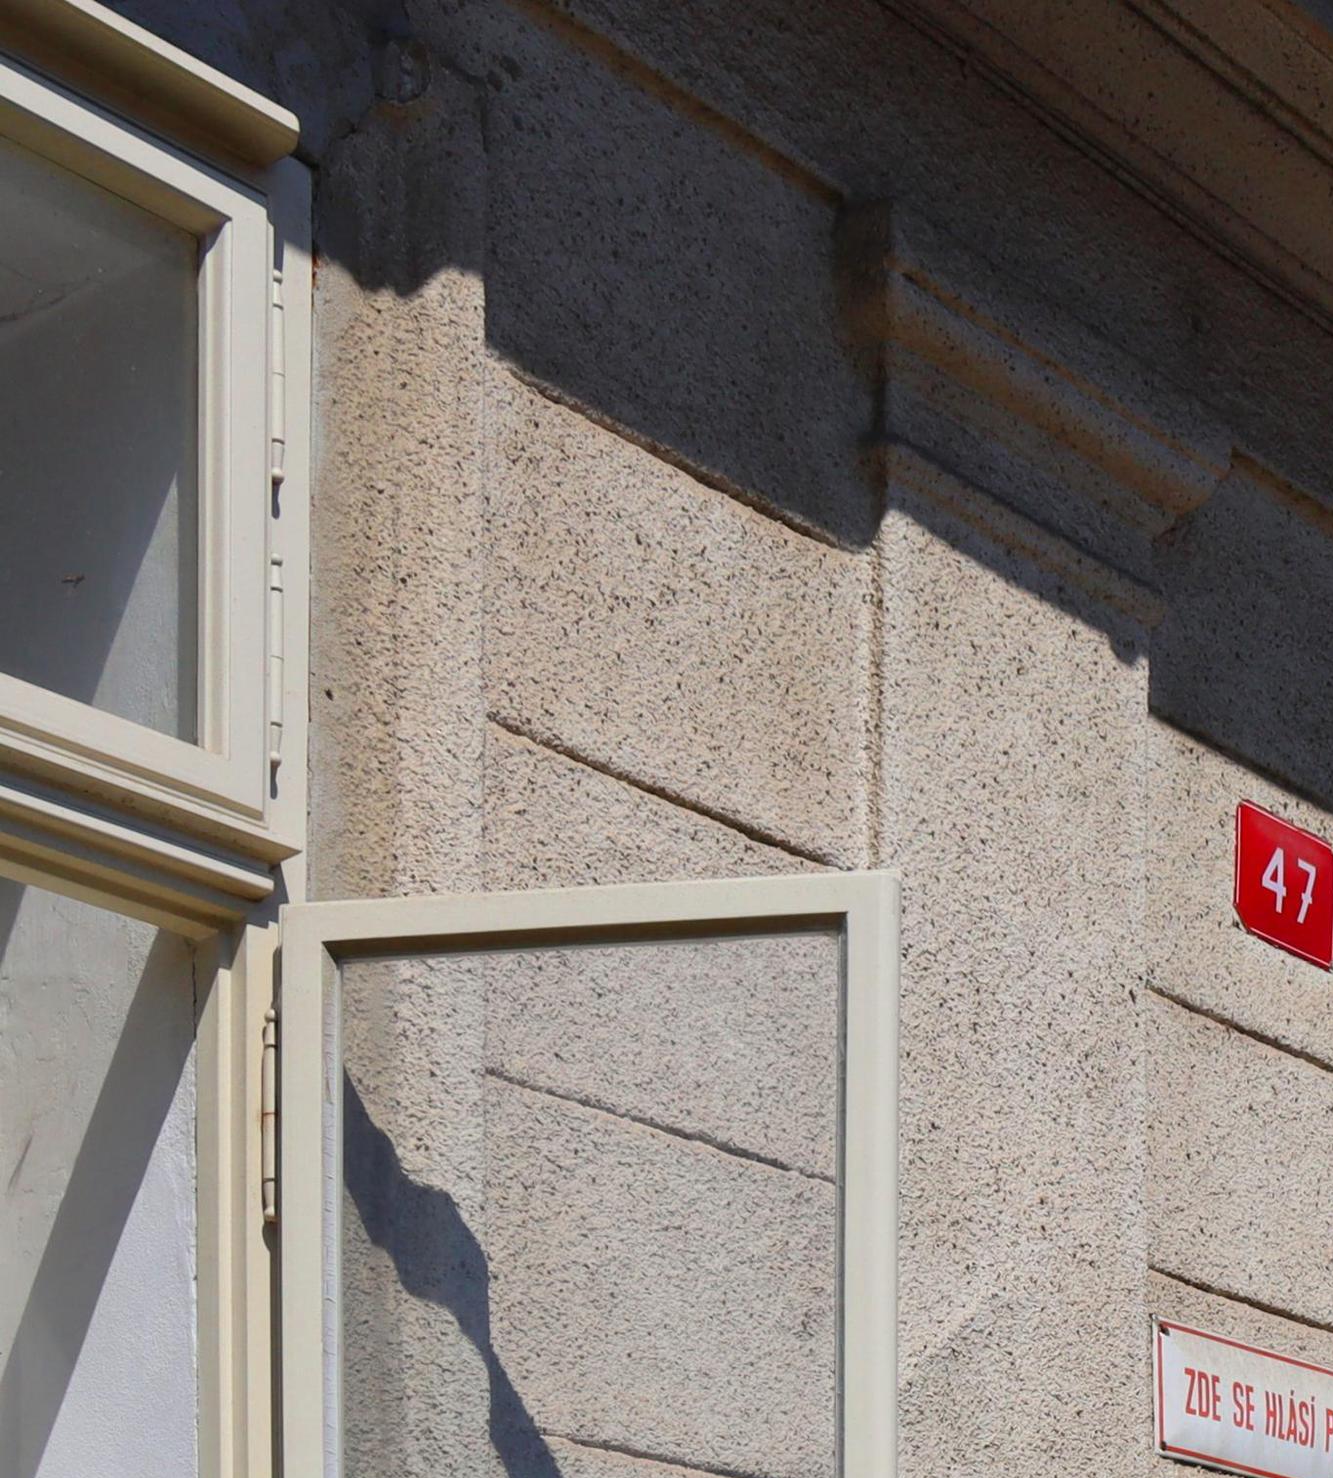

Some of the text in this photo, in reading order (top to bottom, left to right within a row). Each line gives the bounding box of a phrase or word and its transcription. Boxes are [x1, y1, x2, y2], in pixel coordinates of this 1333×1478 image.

[1262, 847, 1317, 924] 47
[1184, 1367, 1222, 1422] ZDE
[1233, 1380, 1256, 1431] SE
[1265, 1390, 1316, 1449] HLÁSÍ
